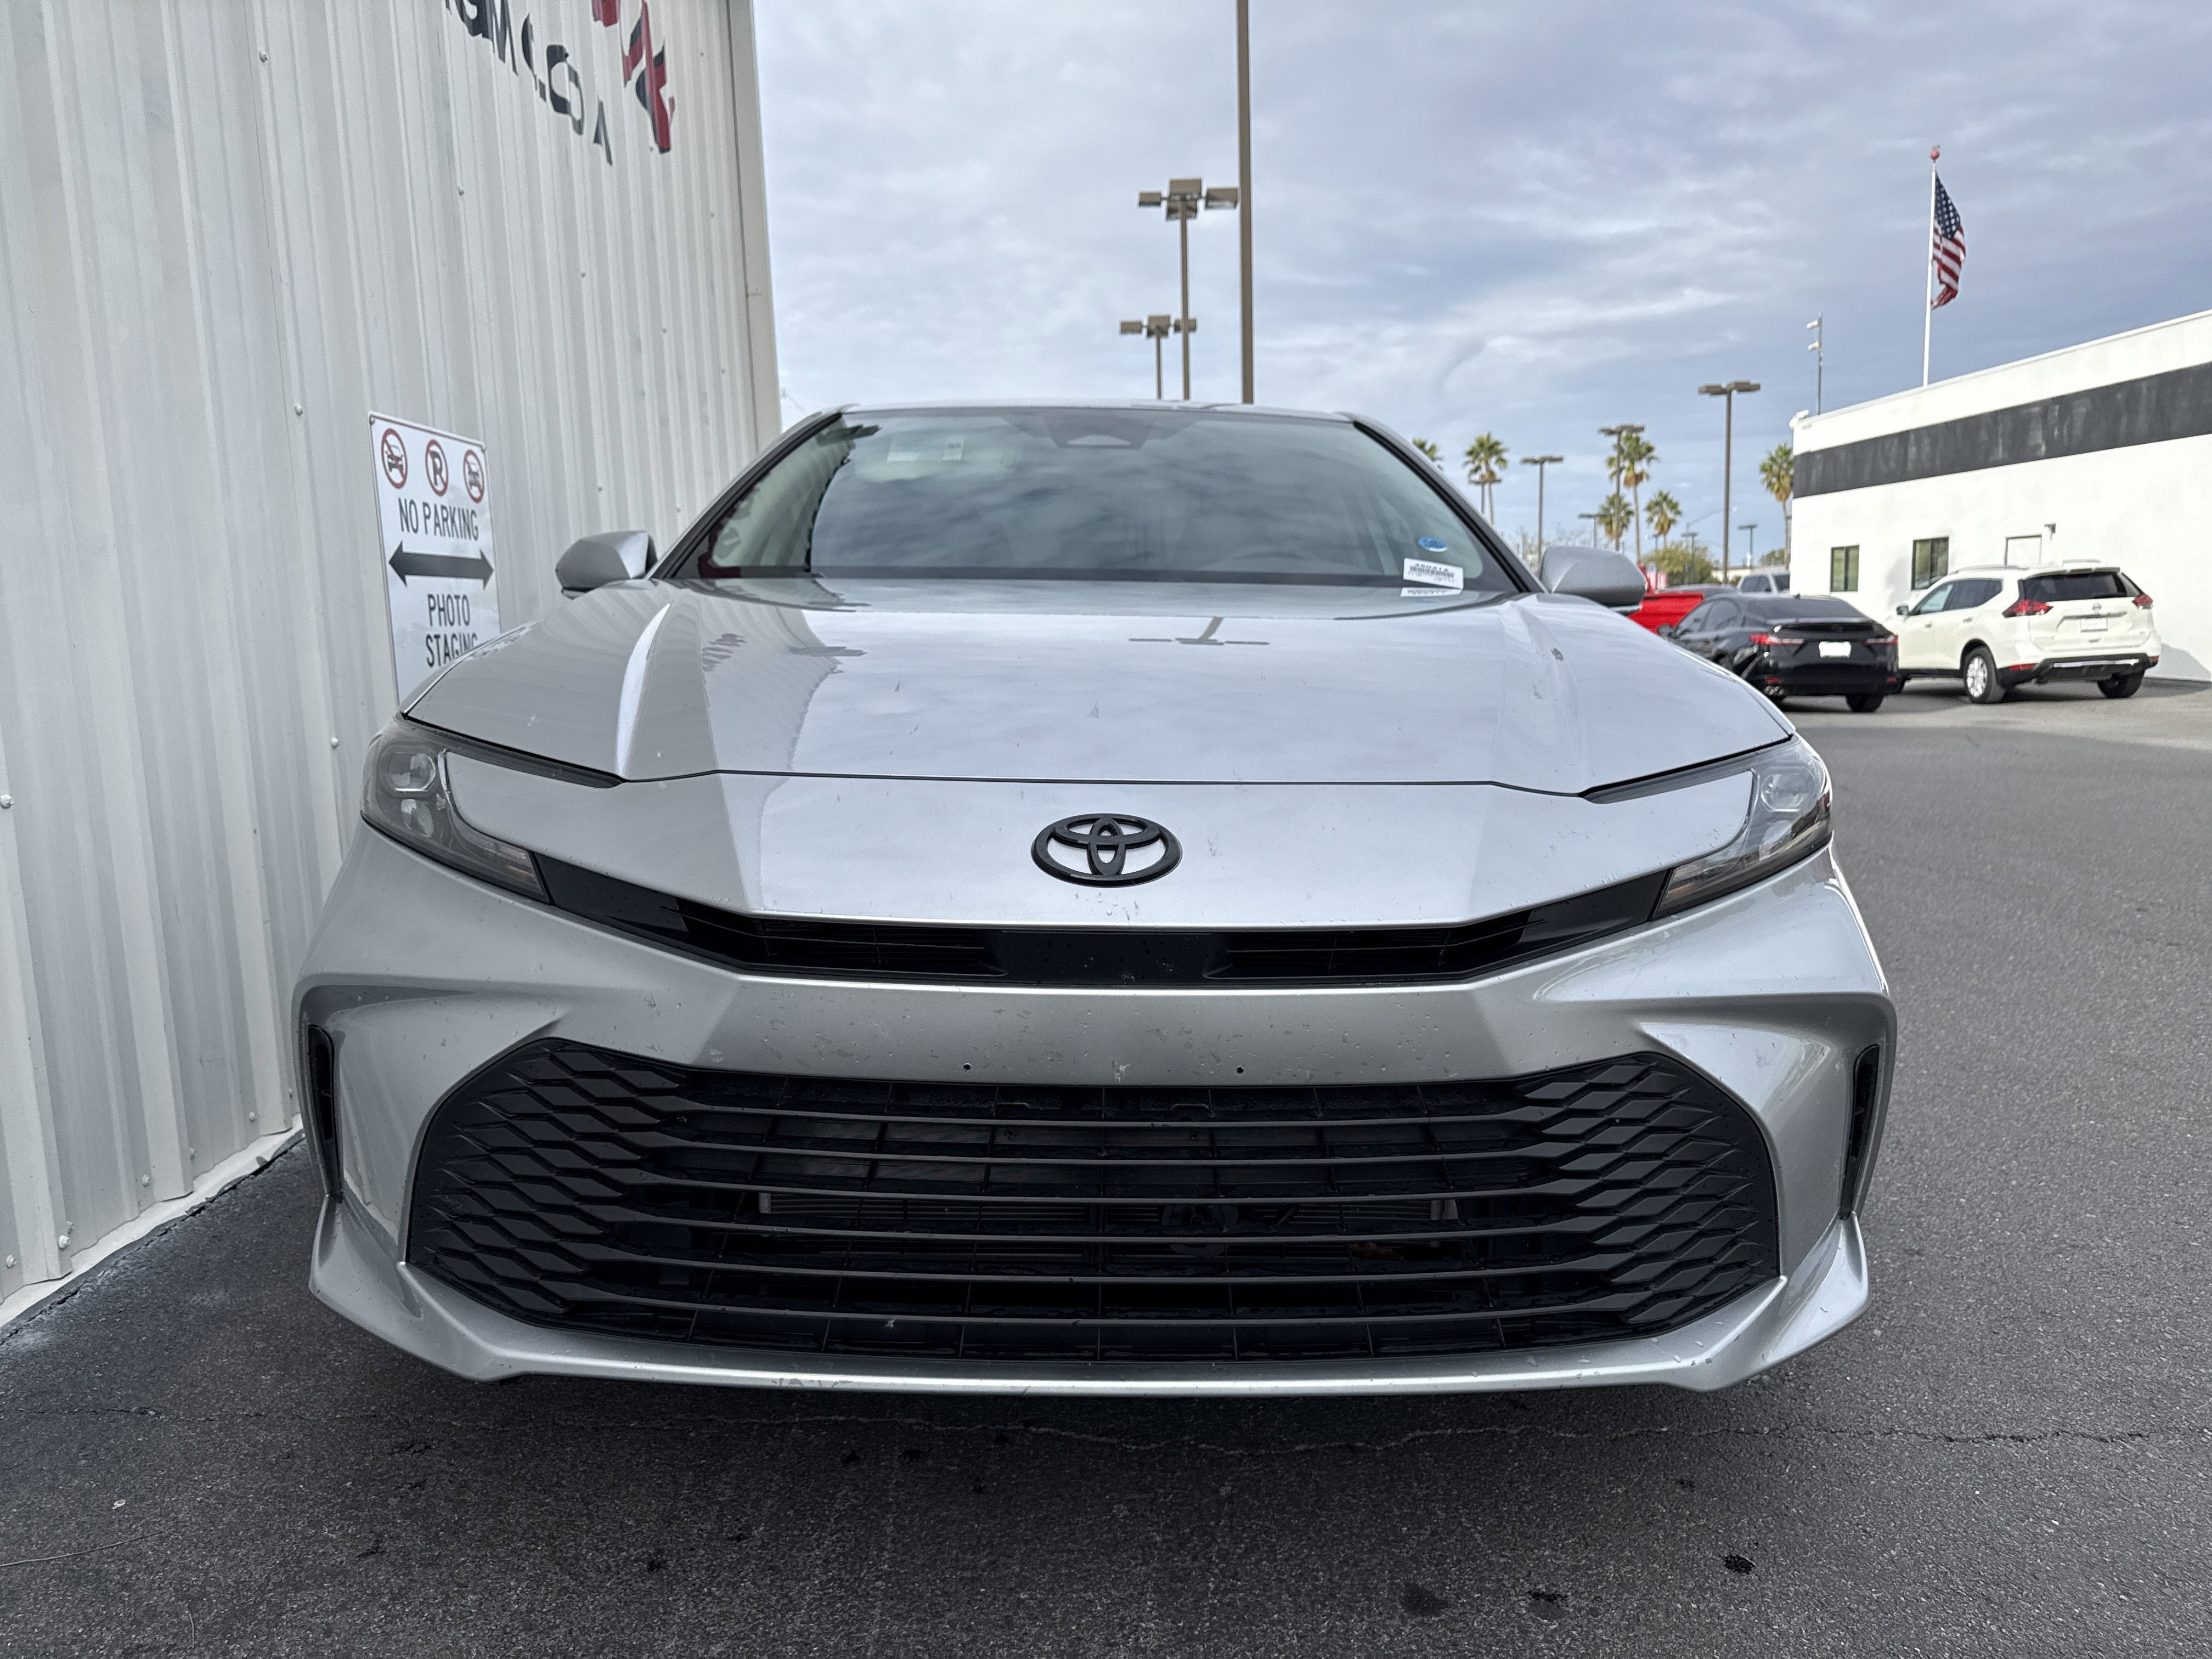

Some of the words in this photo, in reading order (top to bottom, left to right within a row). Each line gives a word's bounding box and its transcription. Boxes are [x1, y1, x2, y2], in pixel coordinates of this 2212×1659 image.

[398, 497, 419, 533] NO
[422, 501, 478, 541] PARKING
[427, 594, 470, 627] PHOTO
